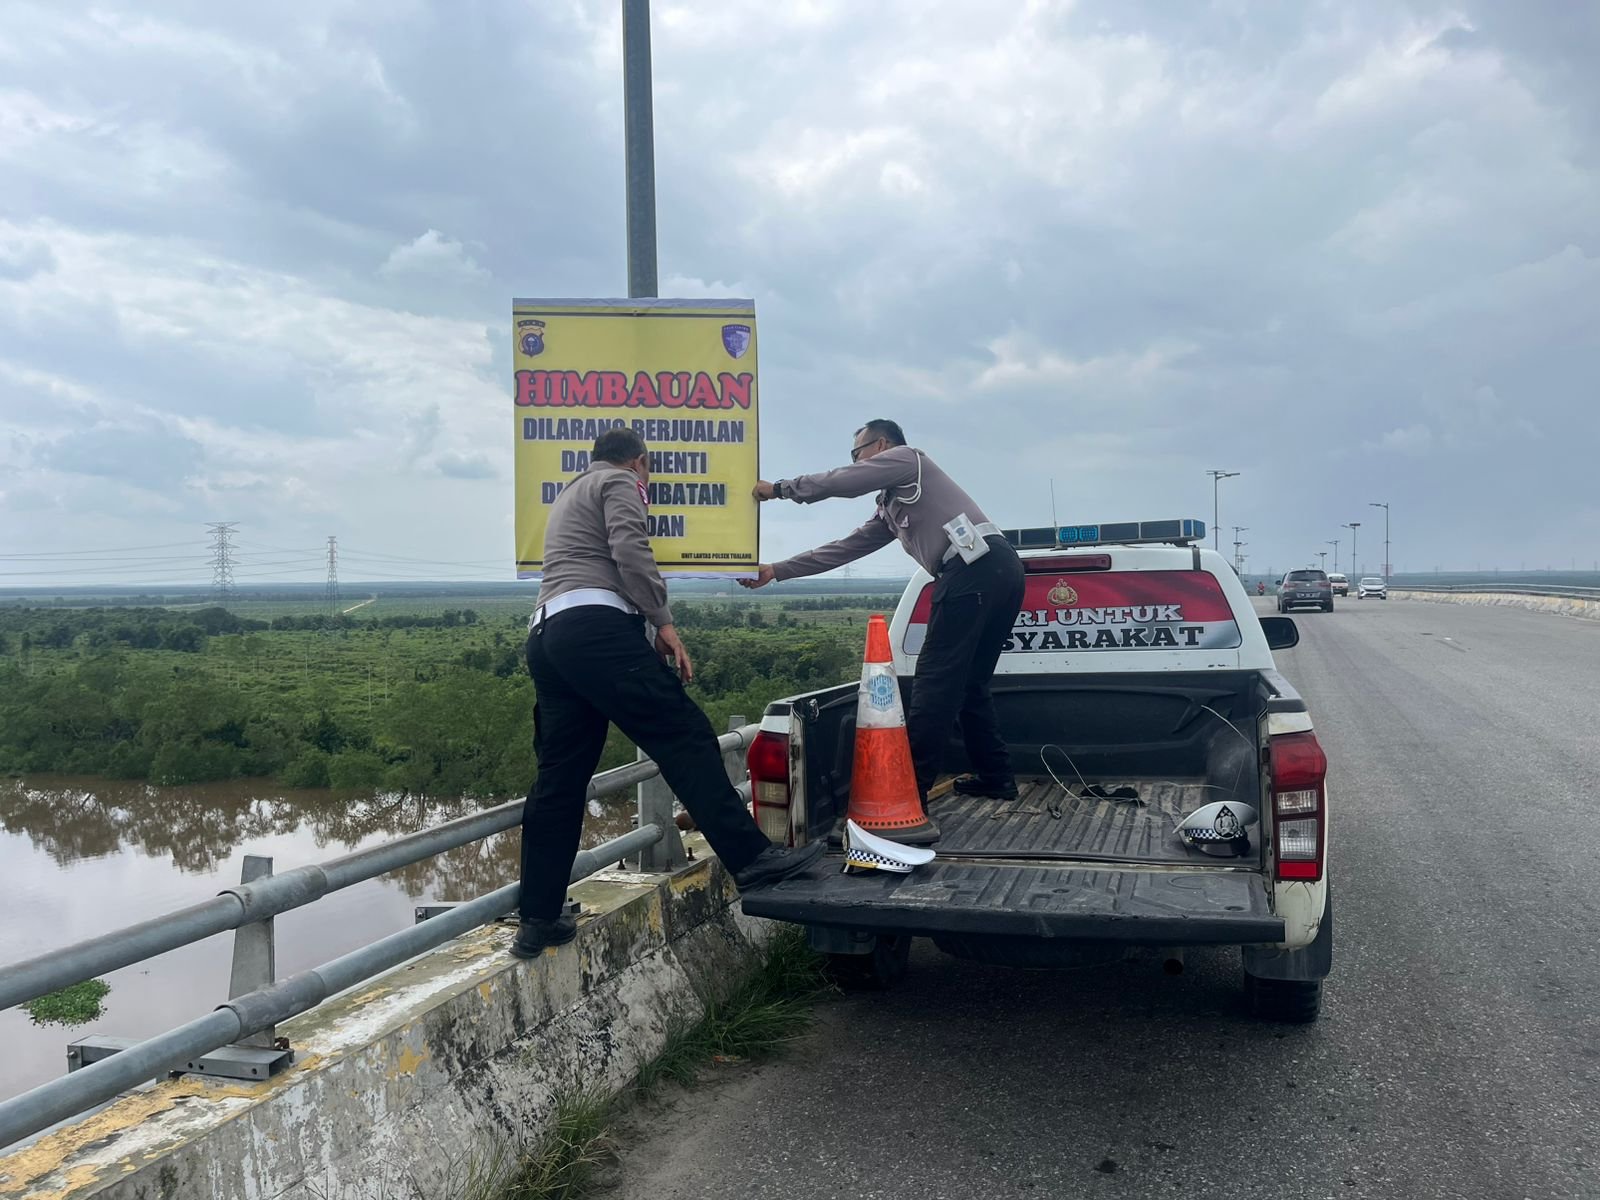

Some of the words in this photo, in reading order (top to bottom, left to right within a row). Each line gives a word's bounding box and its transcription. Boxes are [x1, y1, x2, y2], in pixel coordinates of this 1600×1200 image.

[514, 370, 754, 409] HIMBAUAN
[631, 418, 744, 442] BERJUALAN
[561, 450, 594, 473] DA
[648, 451, 707, 474] HENTI
[1055, 604, 1185, 626] UNTUK
[1000, 626, 1204, 651] SYARAKAT
